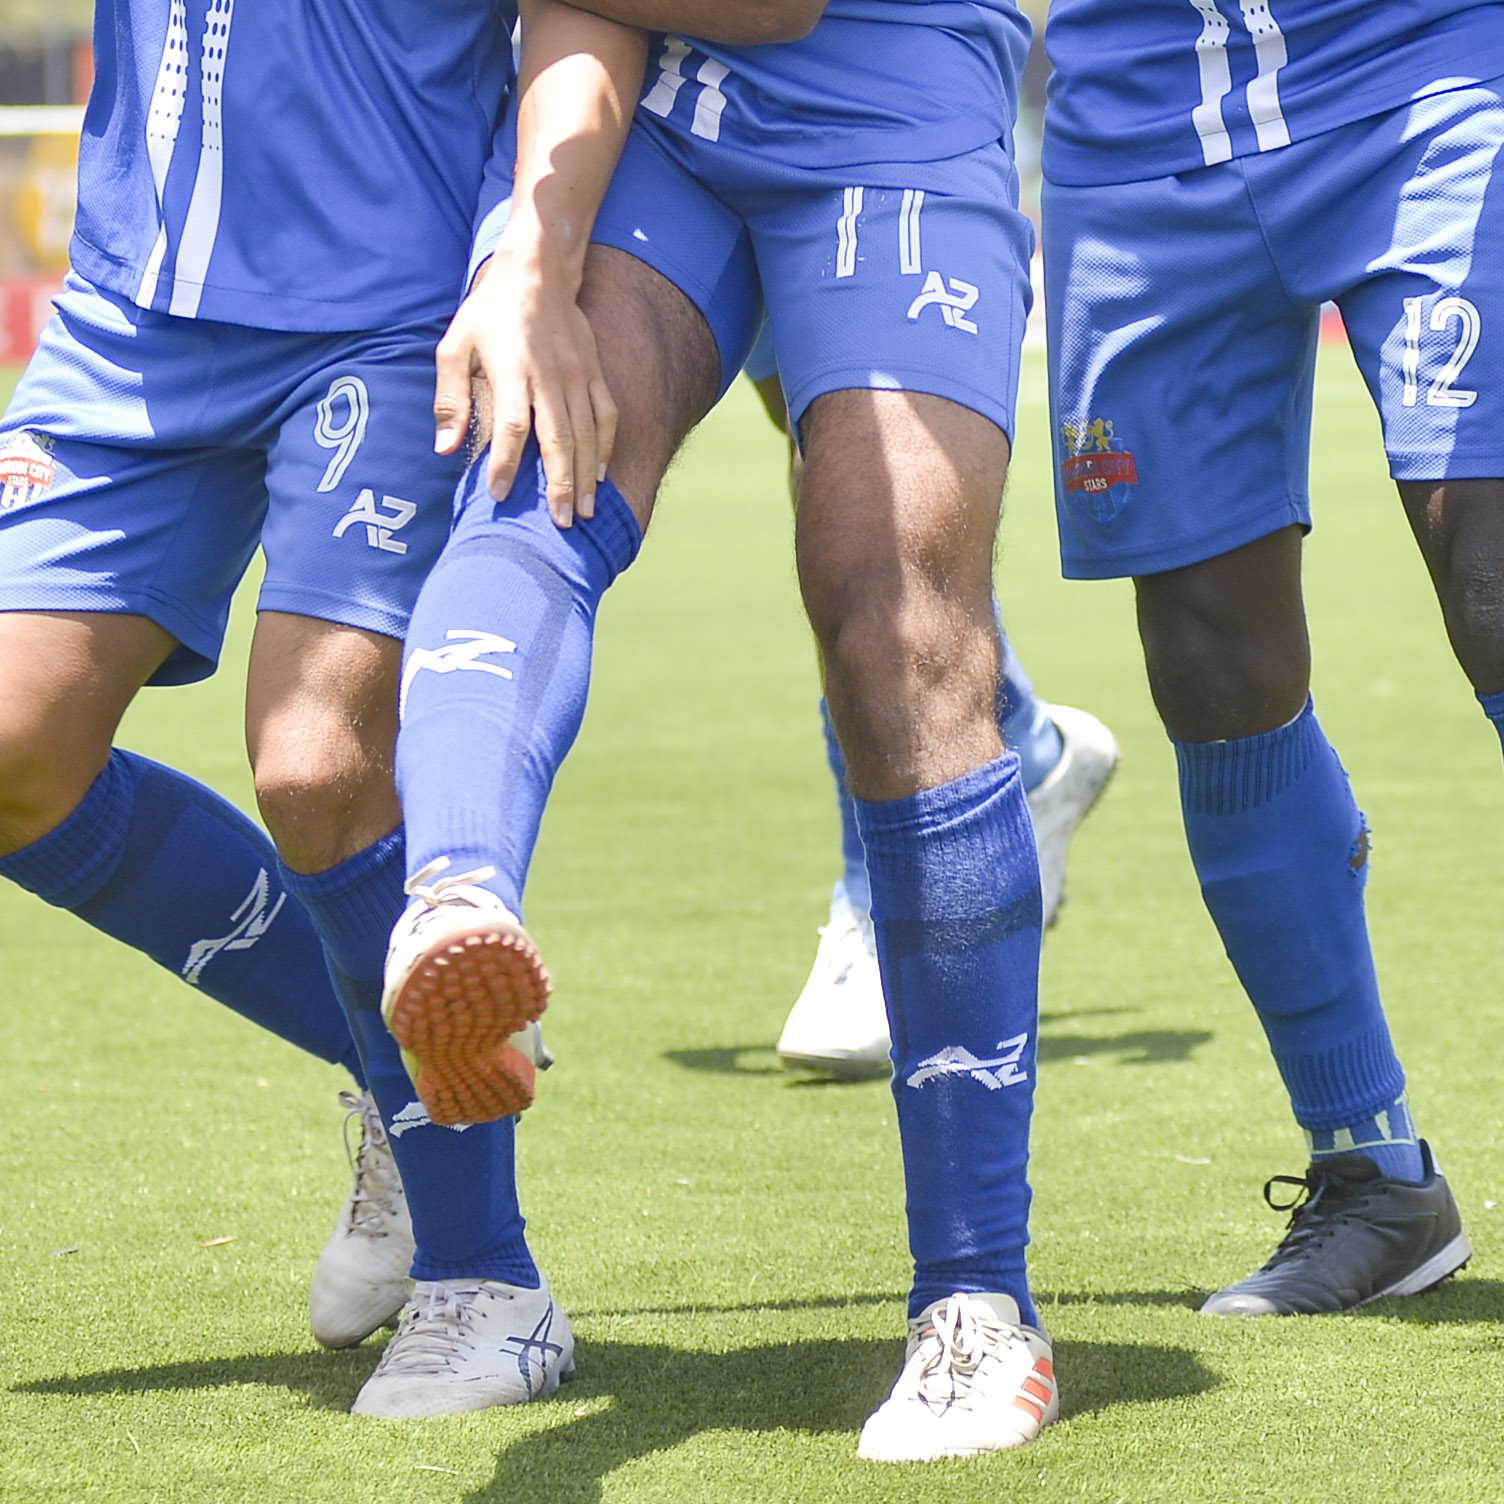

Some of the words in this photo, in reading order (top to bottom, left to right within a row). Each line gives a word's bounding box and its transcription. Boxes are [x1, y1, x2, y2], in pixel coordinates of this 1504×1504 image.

[836, 186, 925, 279] 11
[1402, 296, 1482, 408] 12
[313, 375, 370, 493] 9
[1084, 477, 1108, 492] STARS
